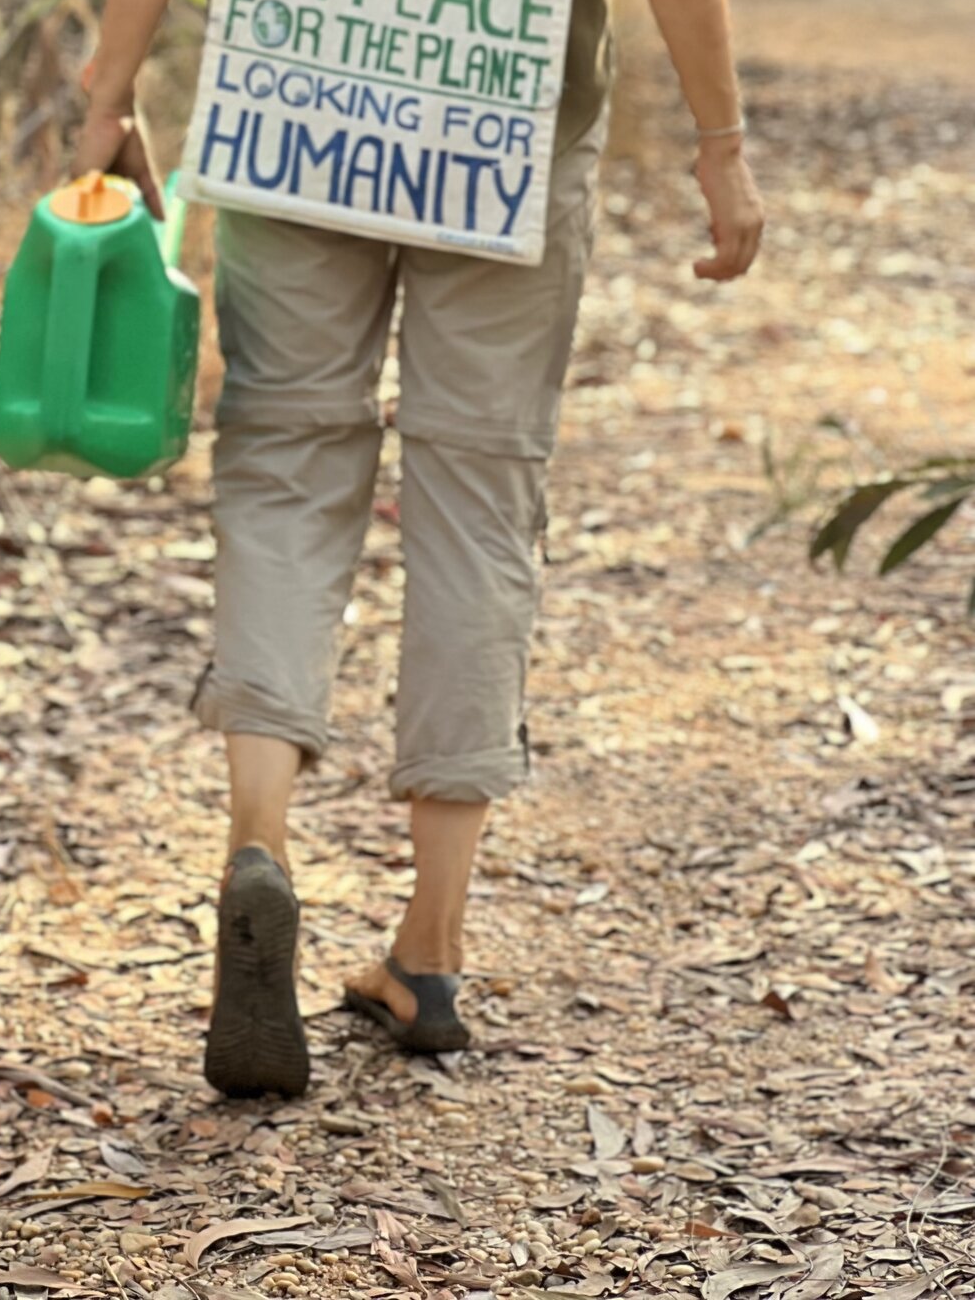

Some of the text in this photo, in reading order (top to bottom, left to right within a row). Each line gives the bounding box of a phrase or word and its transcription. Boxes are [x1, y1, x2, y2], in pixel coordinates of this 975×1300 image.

[217, 55, 533, 156] LOOKING FOR
[338, 16, 409, 75] THE
[416, 34, 550, 105] PLANET
[200, 105, 532, 235] HUMANITY
